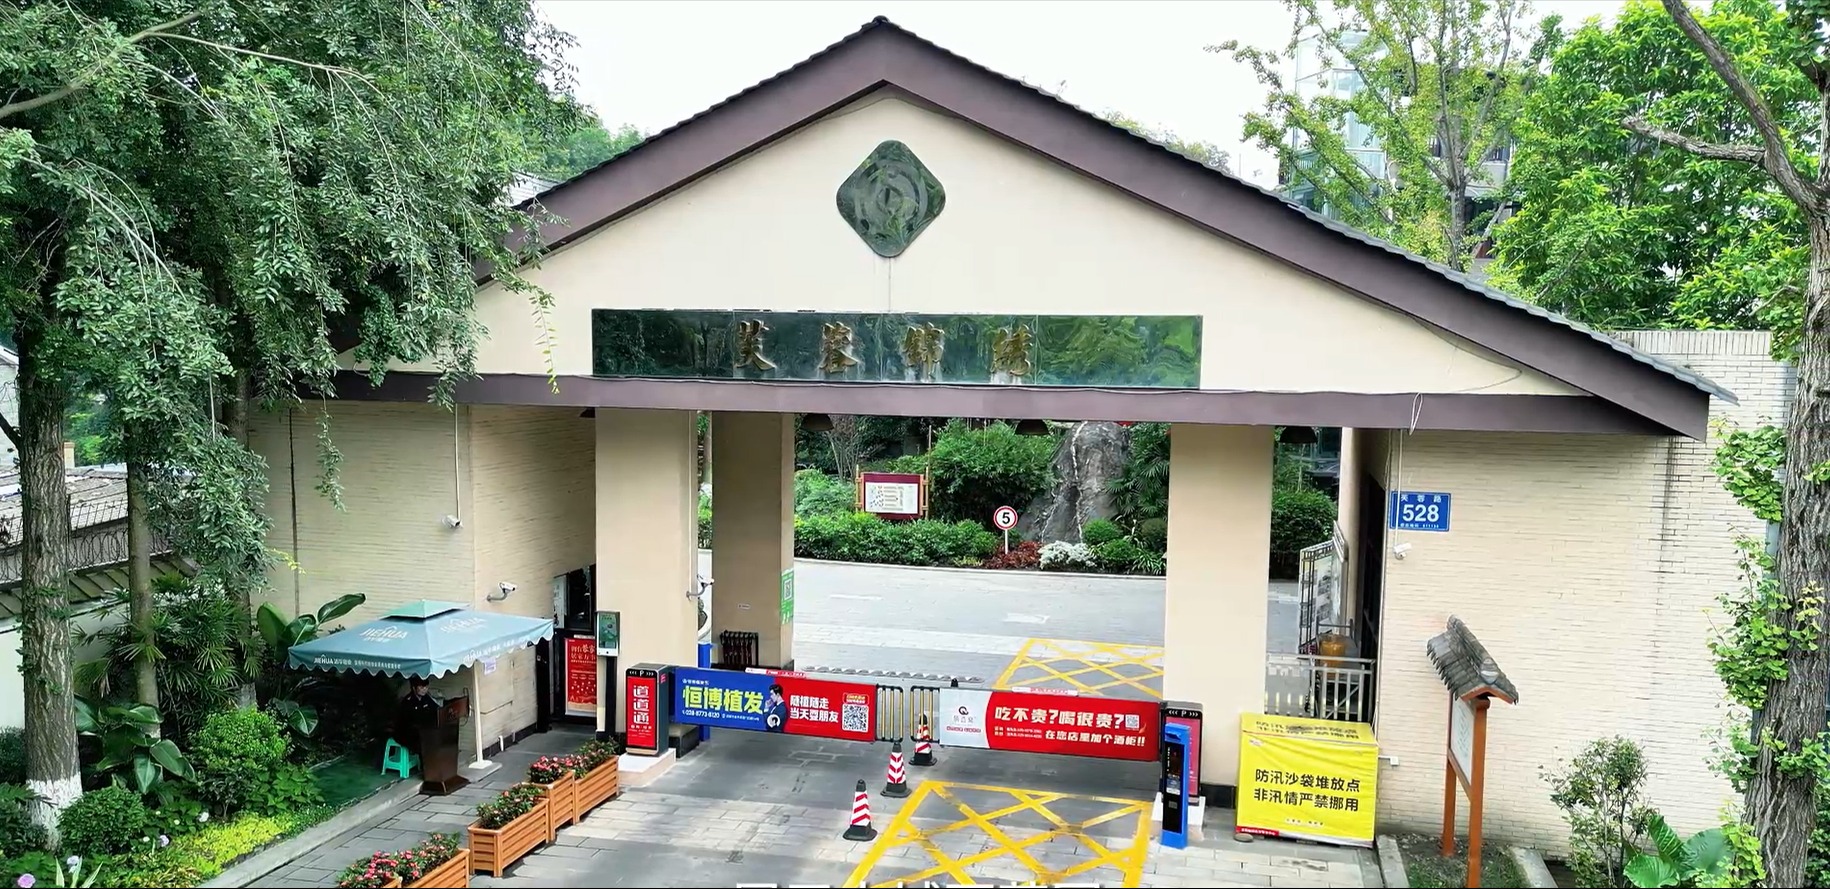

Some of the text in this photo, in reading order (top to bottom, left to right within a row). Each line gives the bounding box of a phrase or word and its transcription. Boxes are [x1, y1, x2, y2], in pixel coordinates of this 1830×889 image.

[1002, 512, 1010, 524] 5
[1402, 504, 1439, 522] 528
[682, 685, 764, 715] 恒博植发
[1255, 768, 1361, 793] 防汛沙袋堆放点
[1254, 788, 1359, 812] 非汛情严禁挪用
